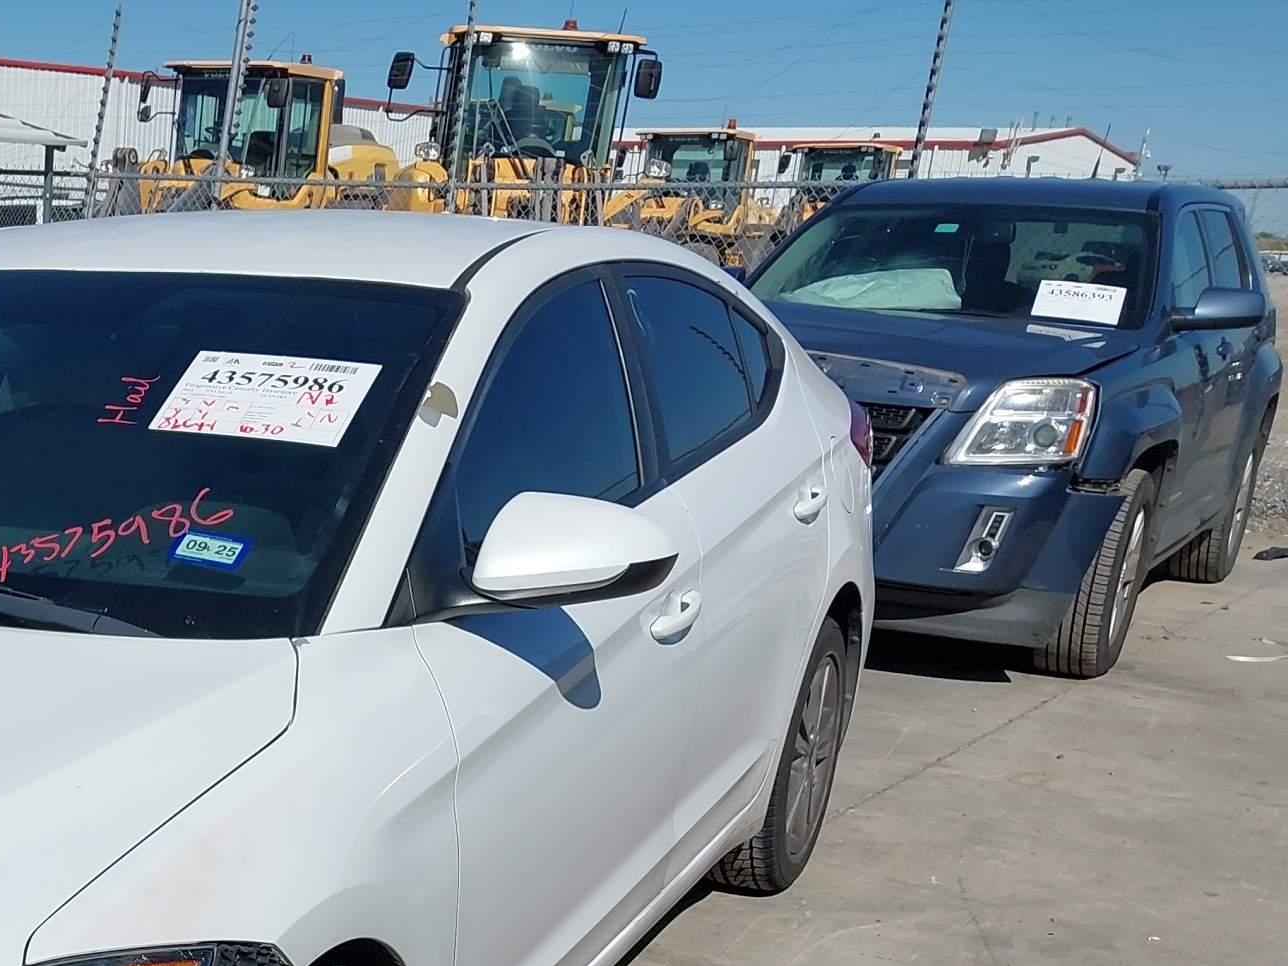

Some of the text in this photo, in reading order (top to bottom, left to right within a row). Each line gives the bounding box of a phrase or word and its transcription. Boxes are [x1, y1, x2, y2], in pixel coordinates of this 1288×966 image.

[200, 369, 352, 394] 43575986
[96, 374, 161, 425] Hail
[185, 539, 239, 558] 09 25
